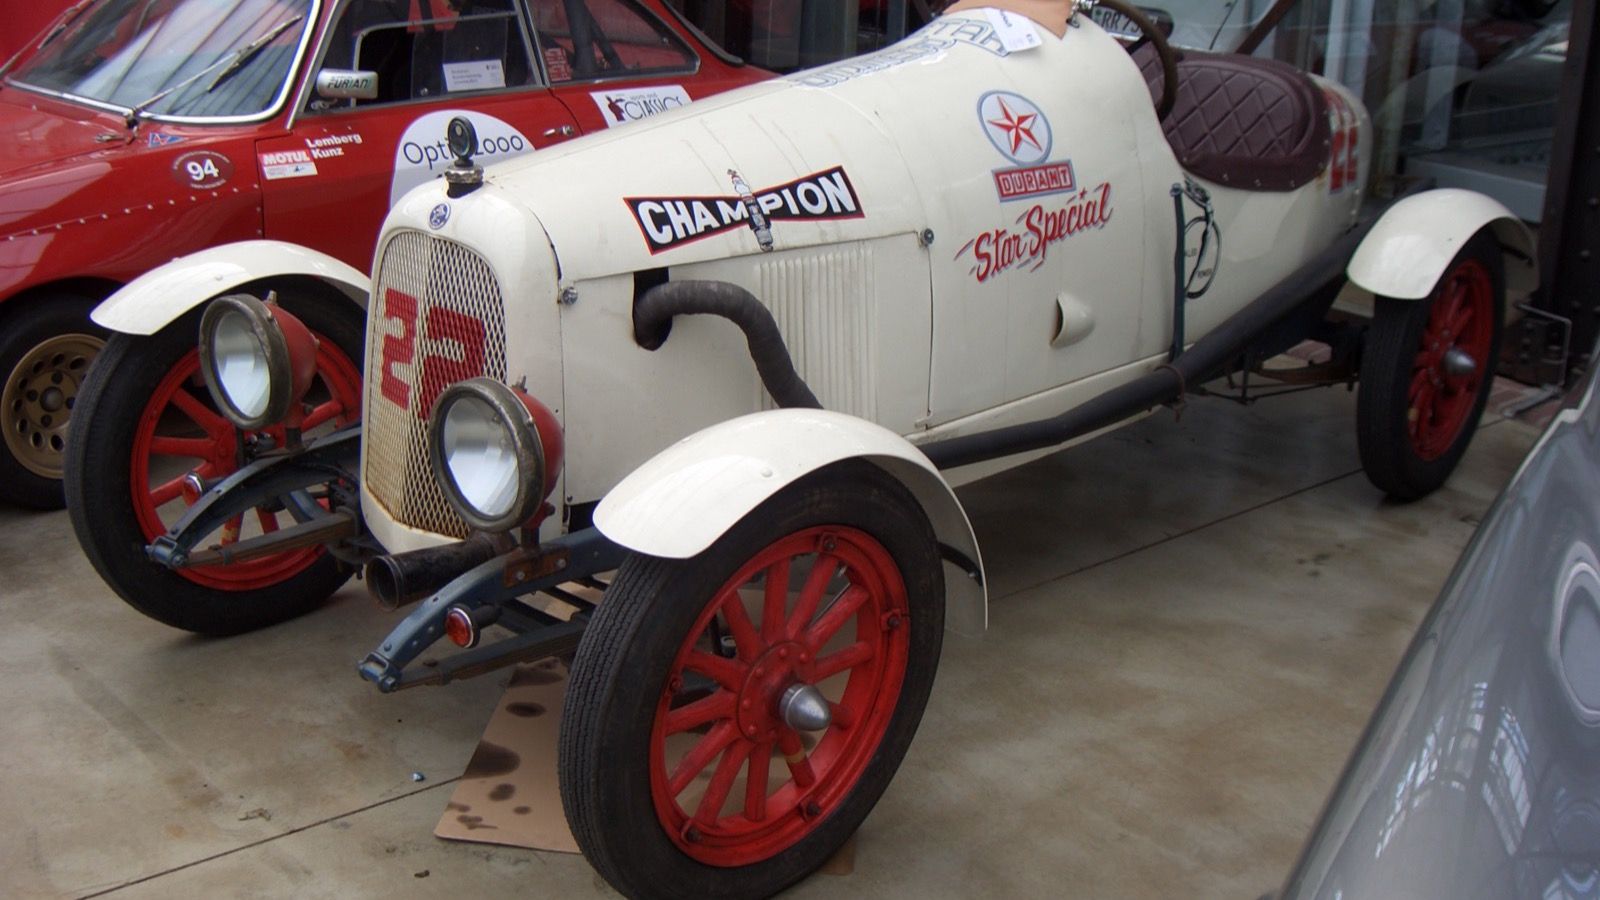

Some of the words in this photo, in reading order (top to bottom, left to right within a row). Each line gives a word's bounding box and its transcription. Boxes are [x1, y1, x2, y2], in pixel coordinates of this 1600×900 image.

[305, 132, 364, 149] Lemberg
[311, 146, 345, 160] Kunz
[403, 136, 458, 170] Opti
[186, 158, 220, 182] 94
[262, 150, 311, 166] MOTUL
[1000, 165, 1073, 196] DURANT
[637, 170, 857, 245] CHAMPION
[974, 226, 1027, 284] Star
[1025, 181, 1114, 259] Special
